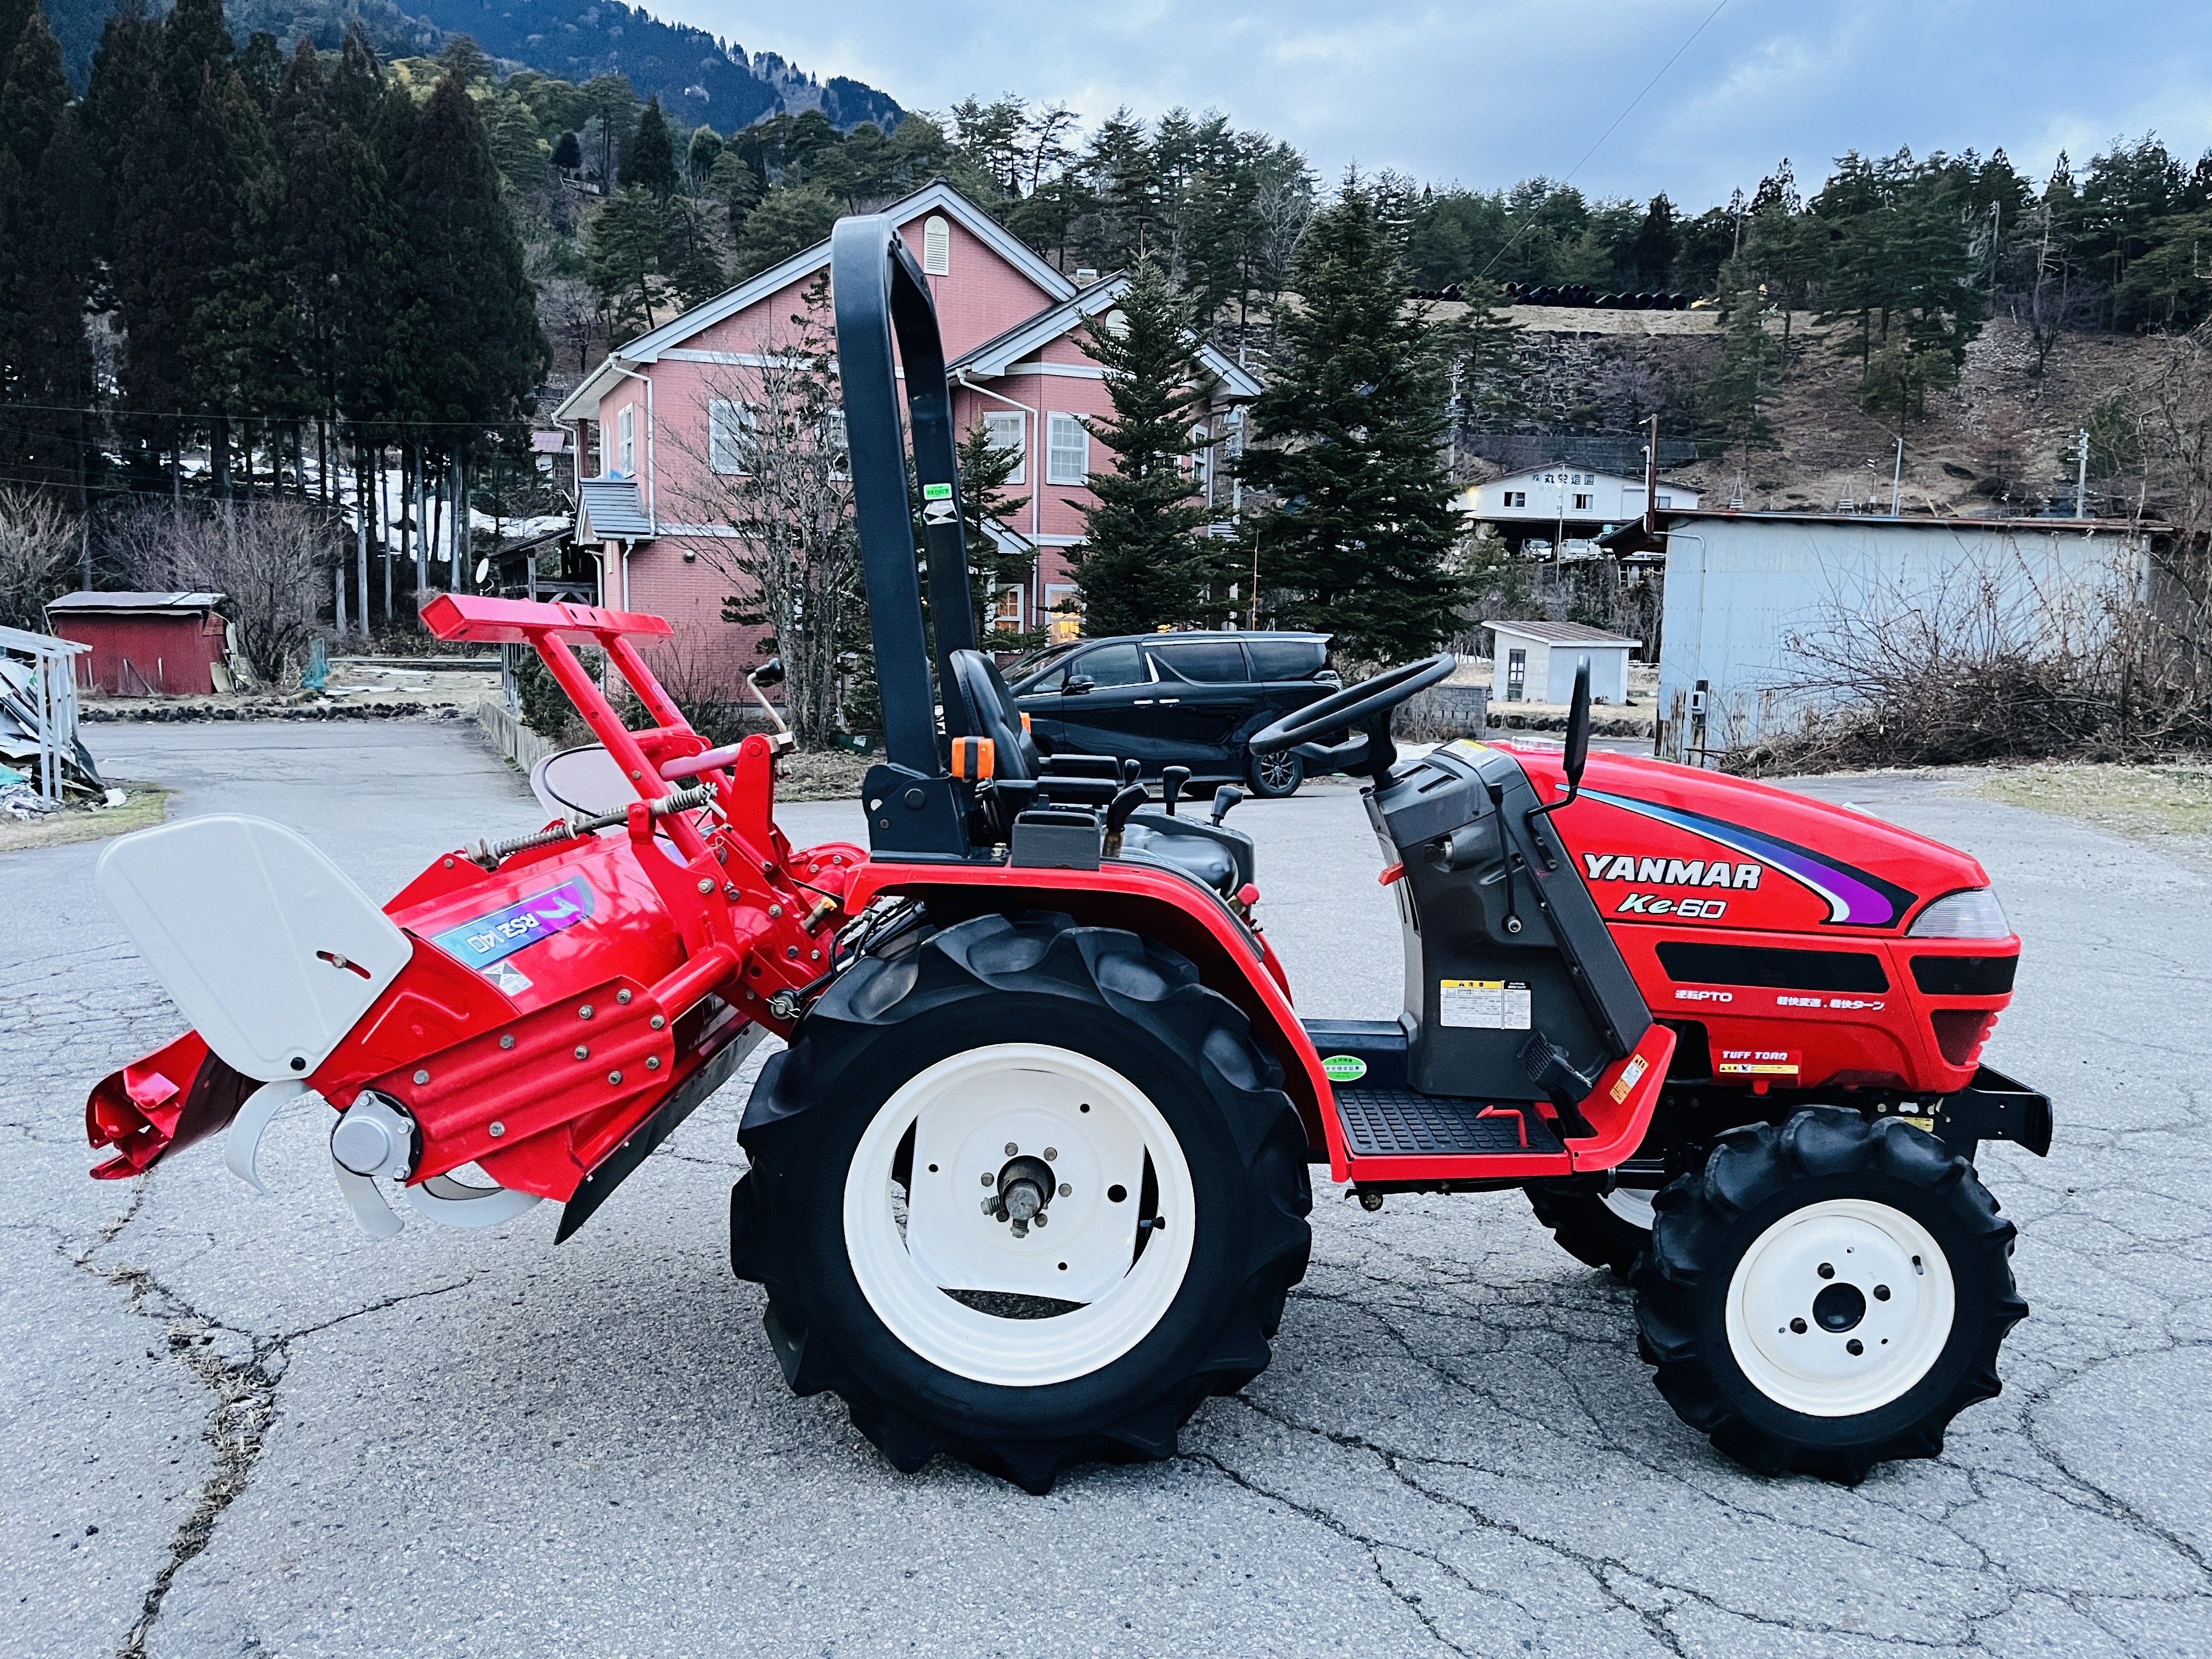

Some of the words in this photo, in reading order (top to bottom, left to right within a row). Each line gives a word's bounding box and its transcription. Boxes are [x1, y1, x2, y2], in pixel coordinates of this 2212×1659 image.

[1583, 854, 1762, 889] YANMAR
[1617, 893, 1727, 919] Ke-60
[495, 912, 541, 939] RSZ
[465, 929, 505, 953] 140
[1722, 1051, 1752, 1059] TUFF
[1754, 1052, 1788, 1062] TORQ
